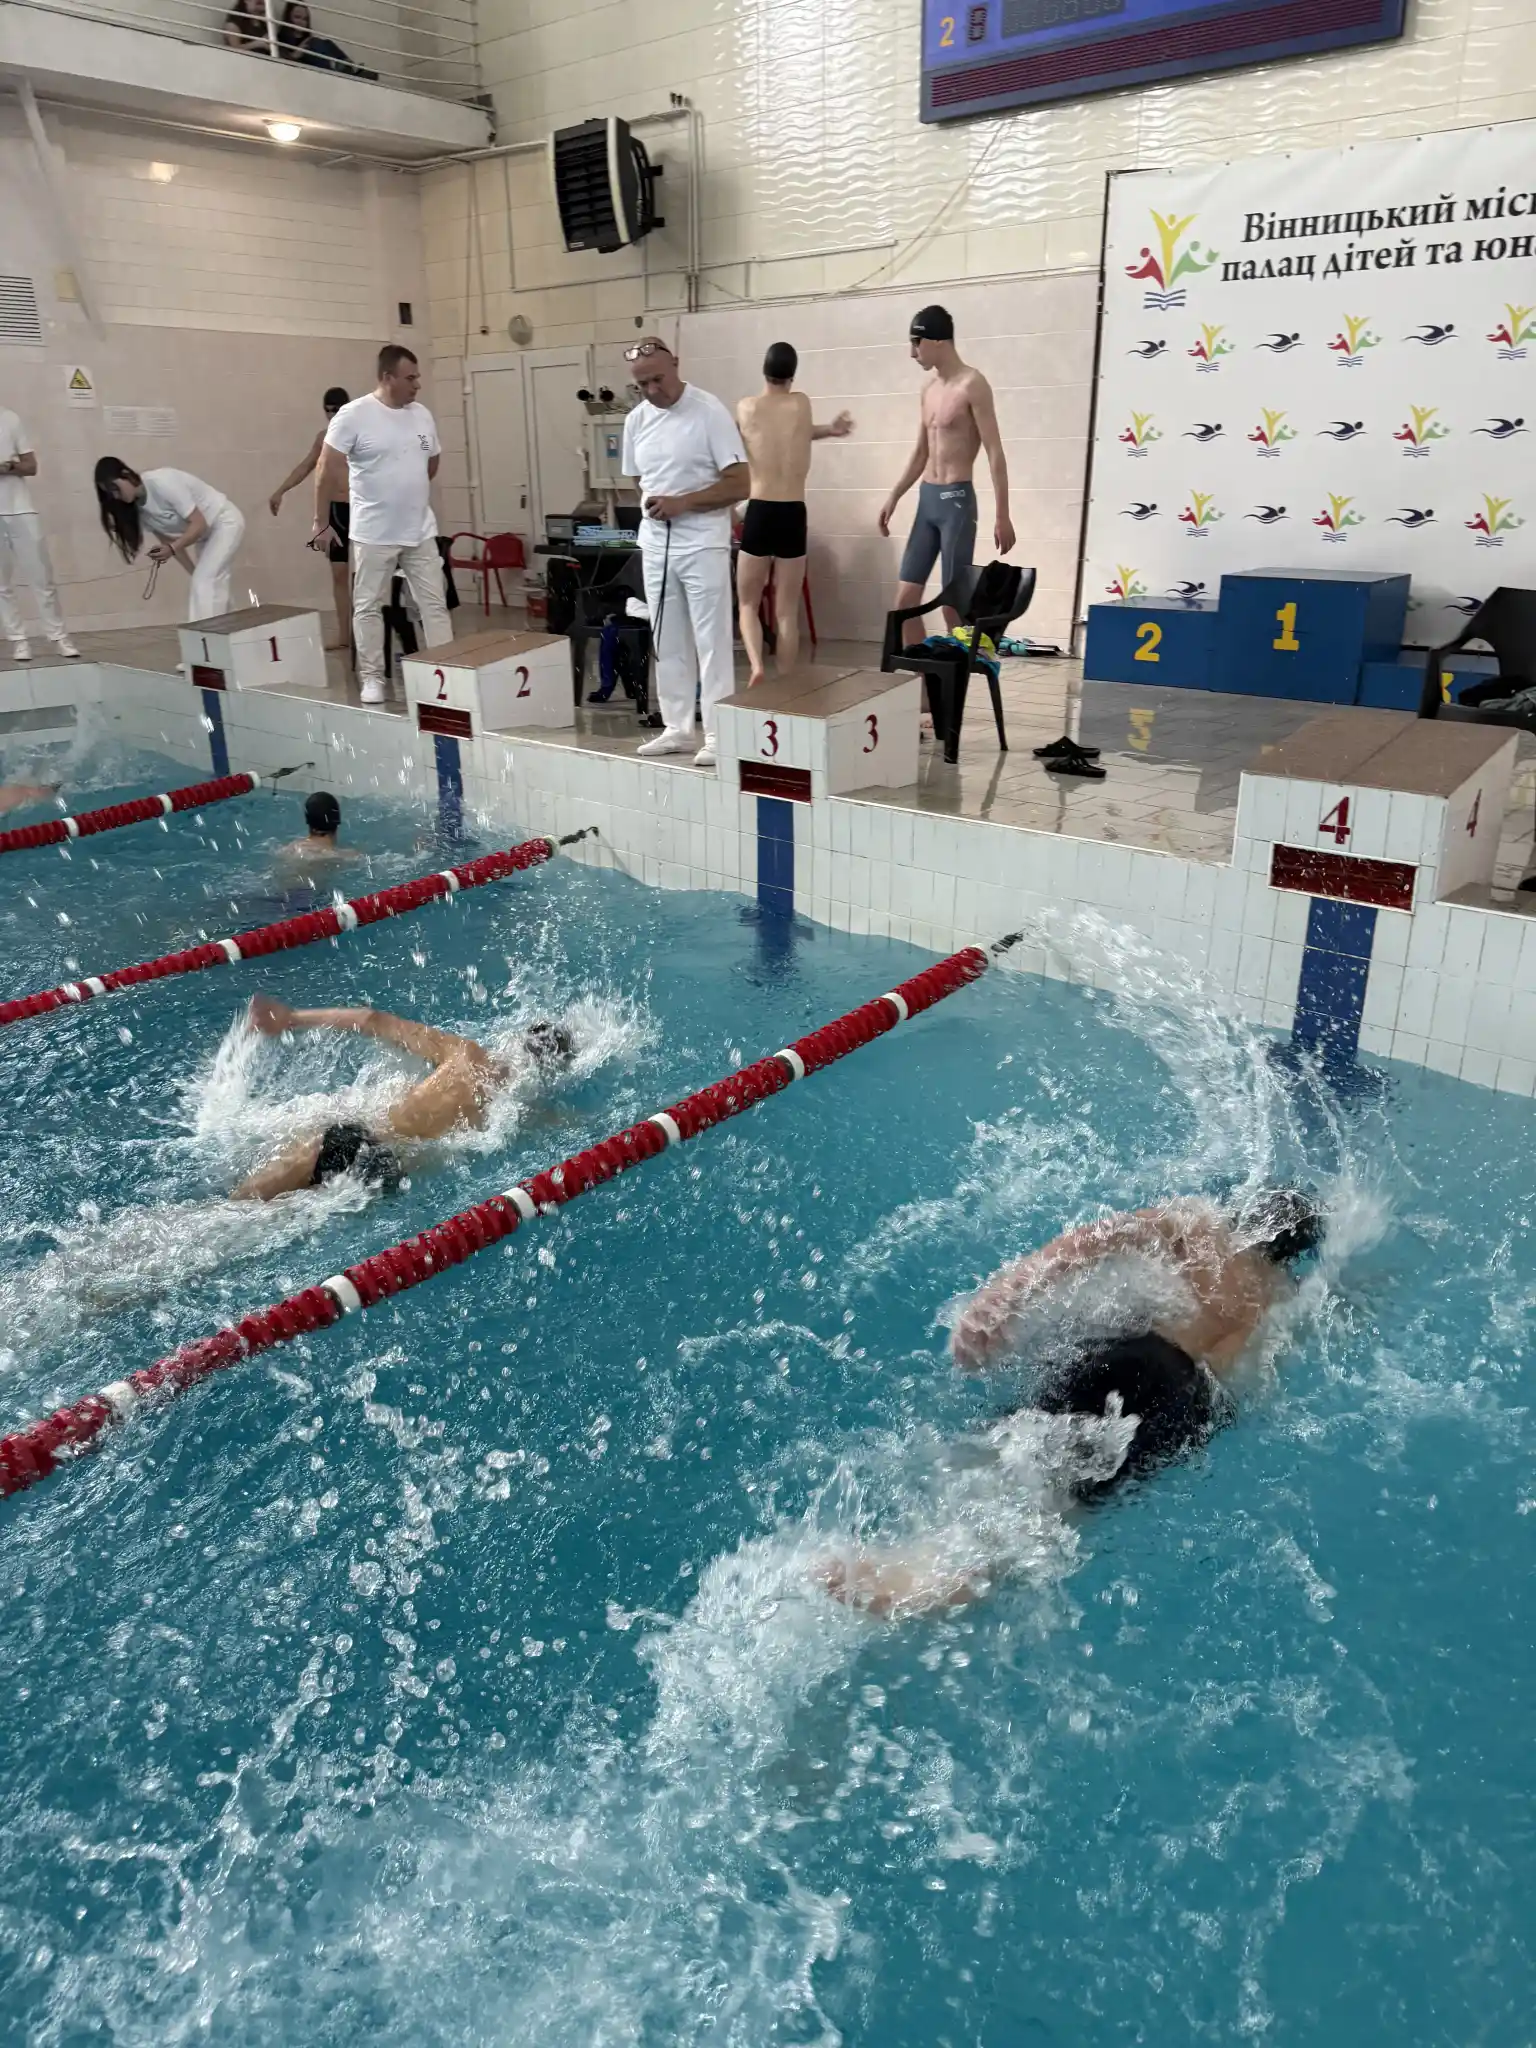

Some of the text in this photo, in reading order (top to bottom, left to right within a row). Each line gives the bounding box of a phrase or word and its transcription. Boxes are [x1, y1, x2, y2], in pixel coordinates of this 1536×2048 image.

[938, 16, 955, 47] 2
[1240, 192, 1458, 243] Вінницький
[1220, 235, 1536, 282] палац дітей та юн
[1134, 621, 1163, 662] 2
[1273, 602, 1299, 651] 1
[201, 637, 211, 662] 1
[268, 635, 282, 662] 1
[433, 669, 447, 700] 2
[515, 666, 531, 698] 2
[761, 720, 779, 757] 3
[863, 714, 879, 753] 3
[1318, 796, 1351, 844] 4
[1466, 788, 1482, 838] 4
